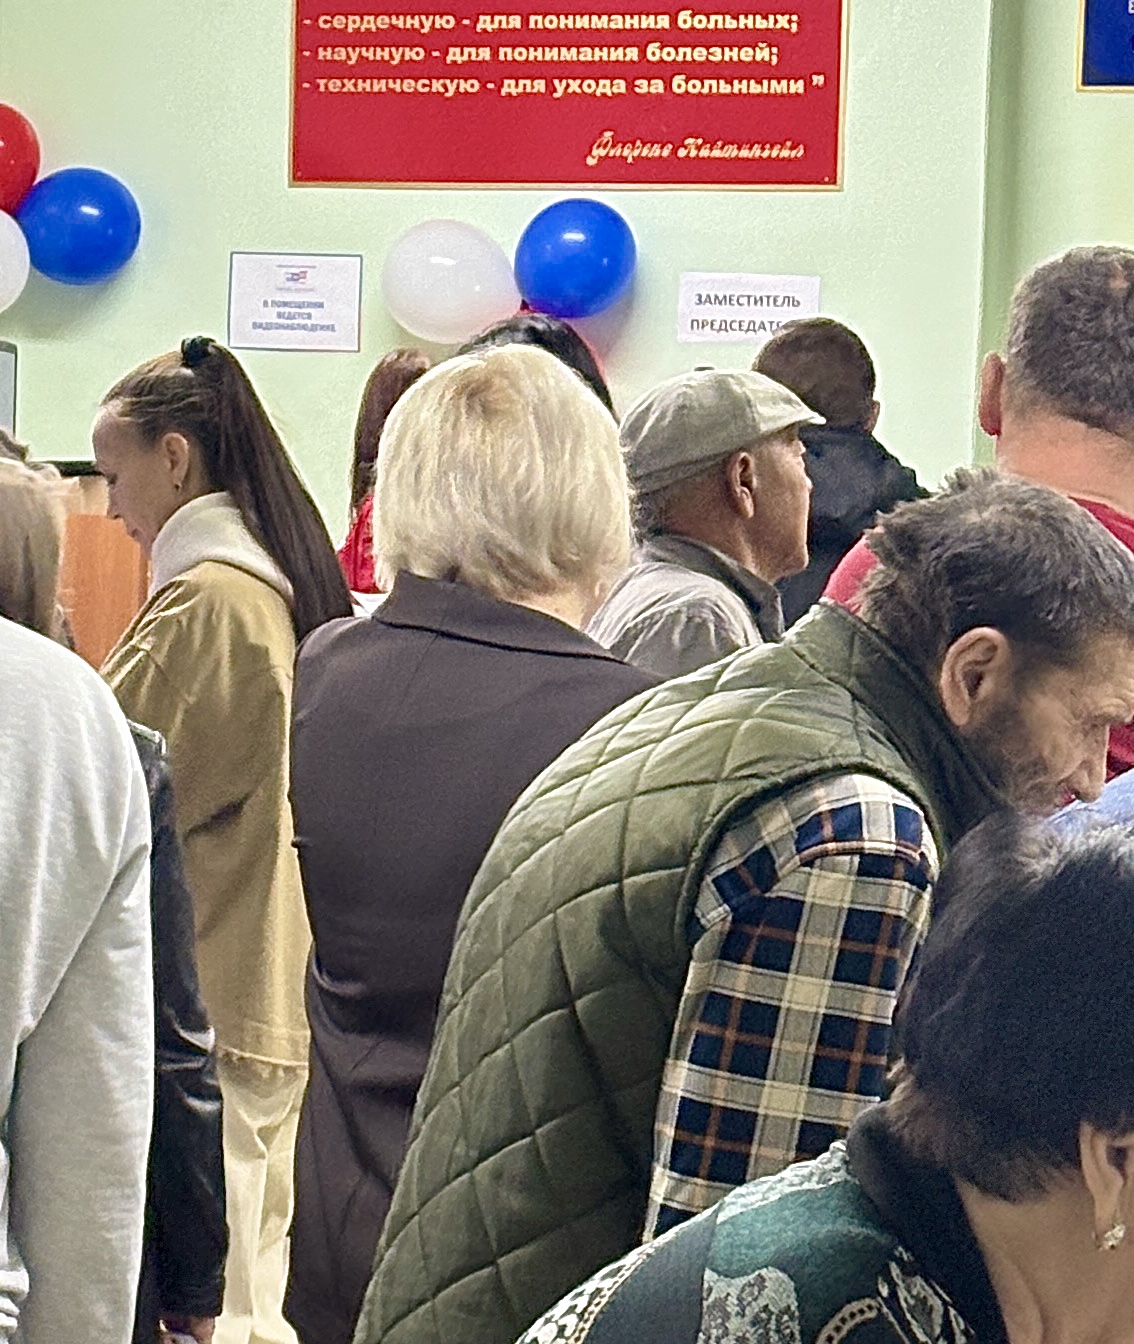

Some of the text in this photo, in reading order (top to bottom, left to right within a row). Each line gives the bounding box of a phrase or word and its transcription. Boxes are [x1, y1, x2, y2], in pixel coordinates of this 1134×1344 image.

[318, 14, 456, 34] сердечную
[475, 14, 522, 33] для
[528, 14, 670, 30] понимания
[677, 9, 799, 33] больных;
[317, 46, 426, 66] научную
[445, 46, 491, 65] для
[498, 46, 639, 62] понимания
[645, 41, 779, 66] болезней;
[316, 78, 480, 97] техническую
[500, 78, 546, 96] для
[552, 78, 627, 98] ухода
[633, 78, 665, 94] за
[671, 74, 805, 94] больными
[694, 293, 801, 308] ЗАМЕСТИТЕЛЬ
